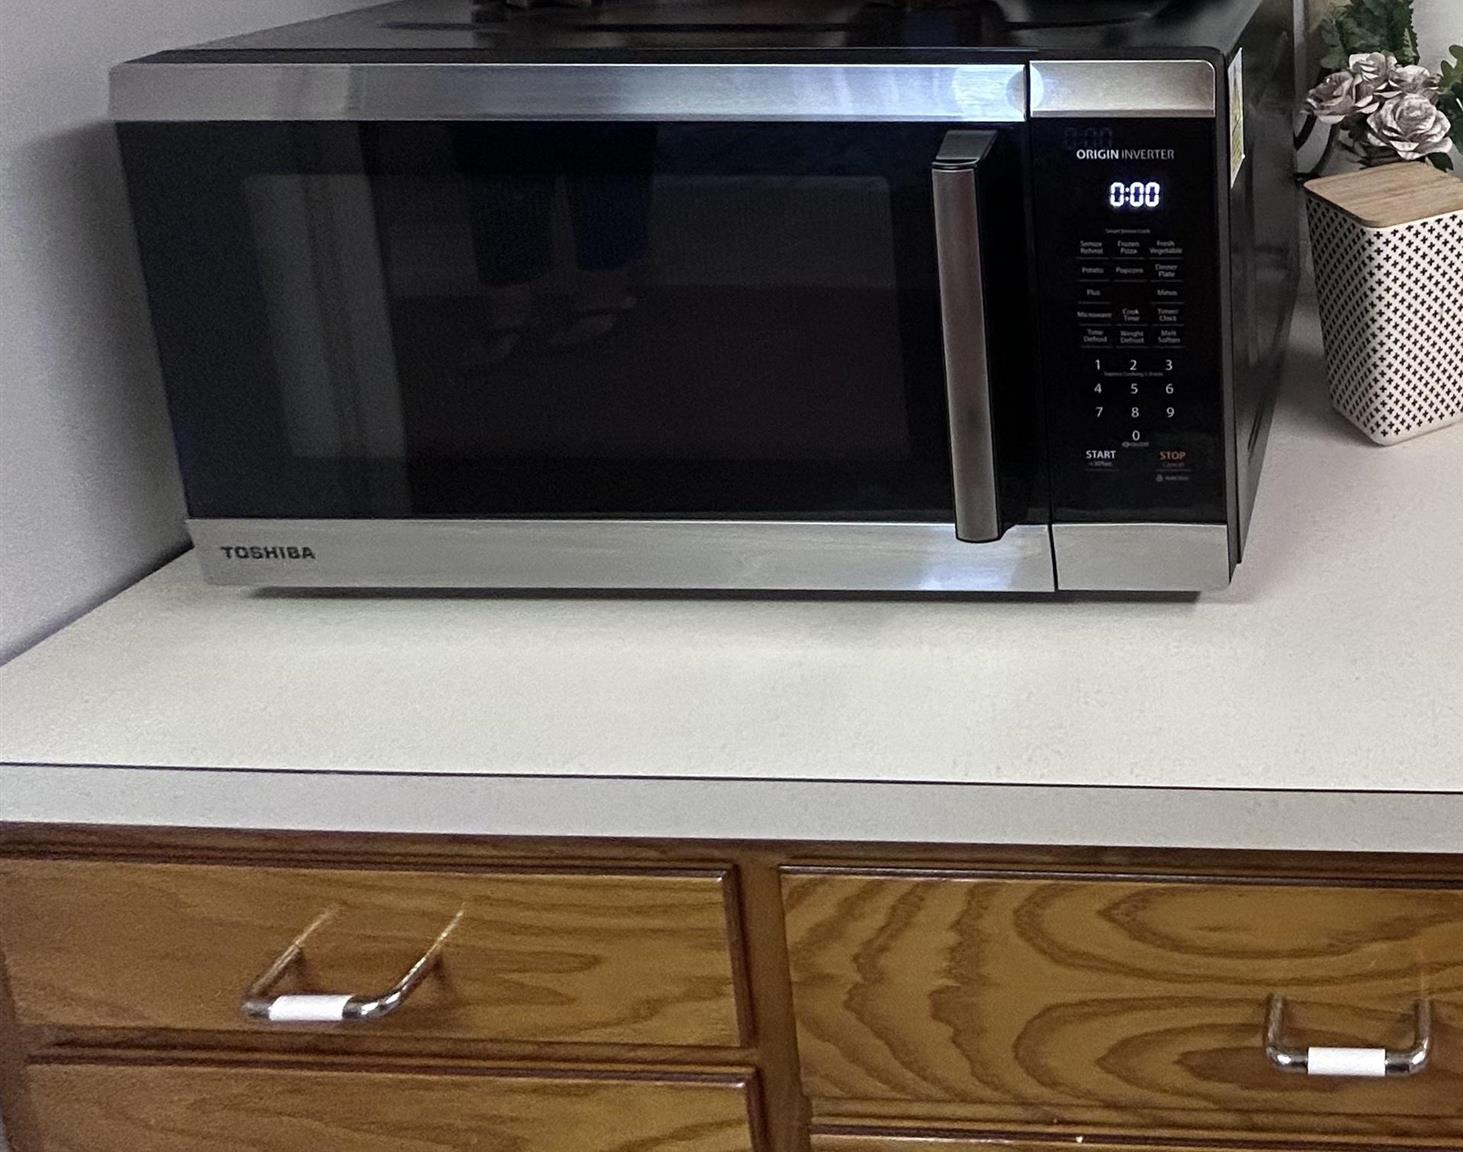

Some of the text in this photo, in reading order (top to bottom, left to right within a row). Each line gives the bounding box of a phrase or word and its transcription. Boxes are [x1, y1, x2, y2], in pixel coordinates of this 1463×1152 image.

[1075, 148, 1175, 160] ORIGIN INVERTER
[1110, 181, 1161, 208] 0:00
[1095, 359, 1174, 371] 1 2 3
[1093, 383, 1175, 394] 4 5 6
[1096, 406, 1175, 418] 7 8 9
[1132, 430, 1141, 442] 0
[1085, 449, 1117, 460] START
[1159, 450, 1187, 461] STOP
[220, 546, 316, 559] TOSHIBA
